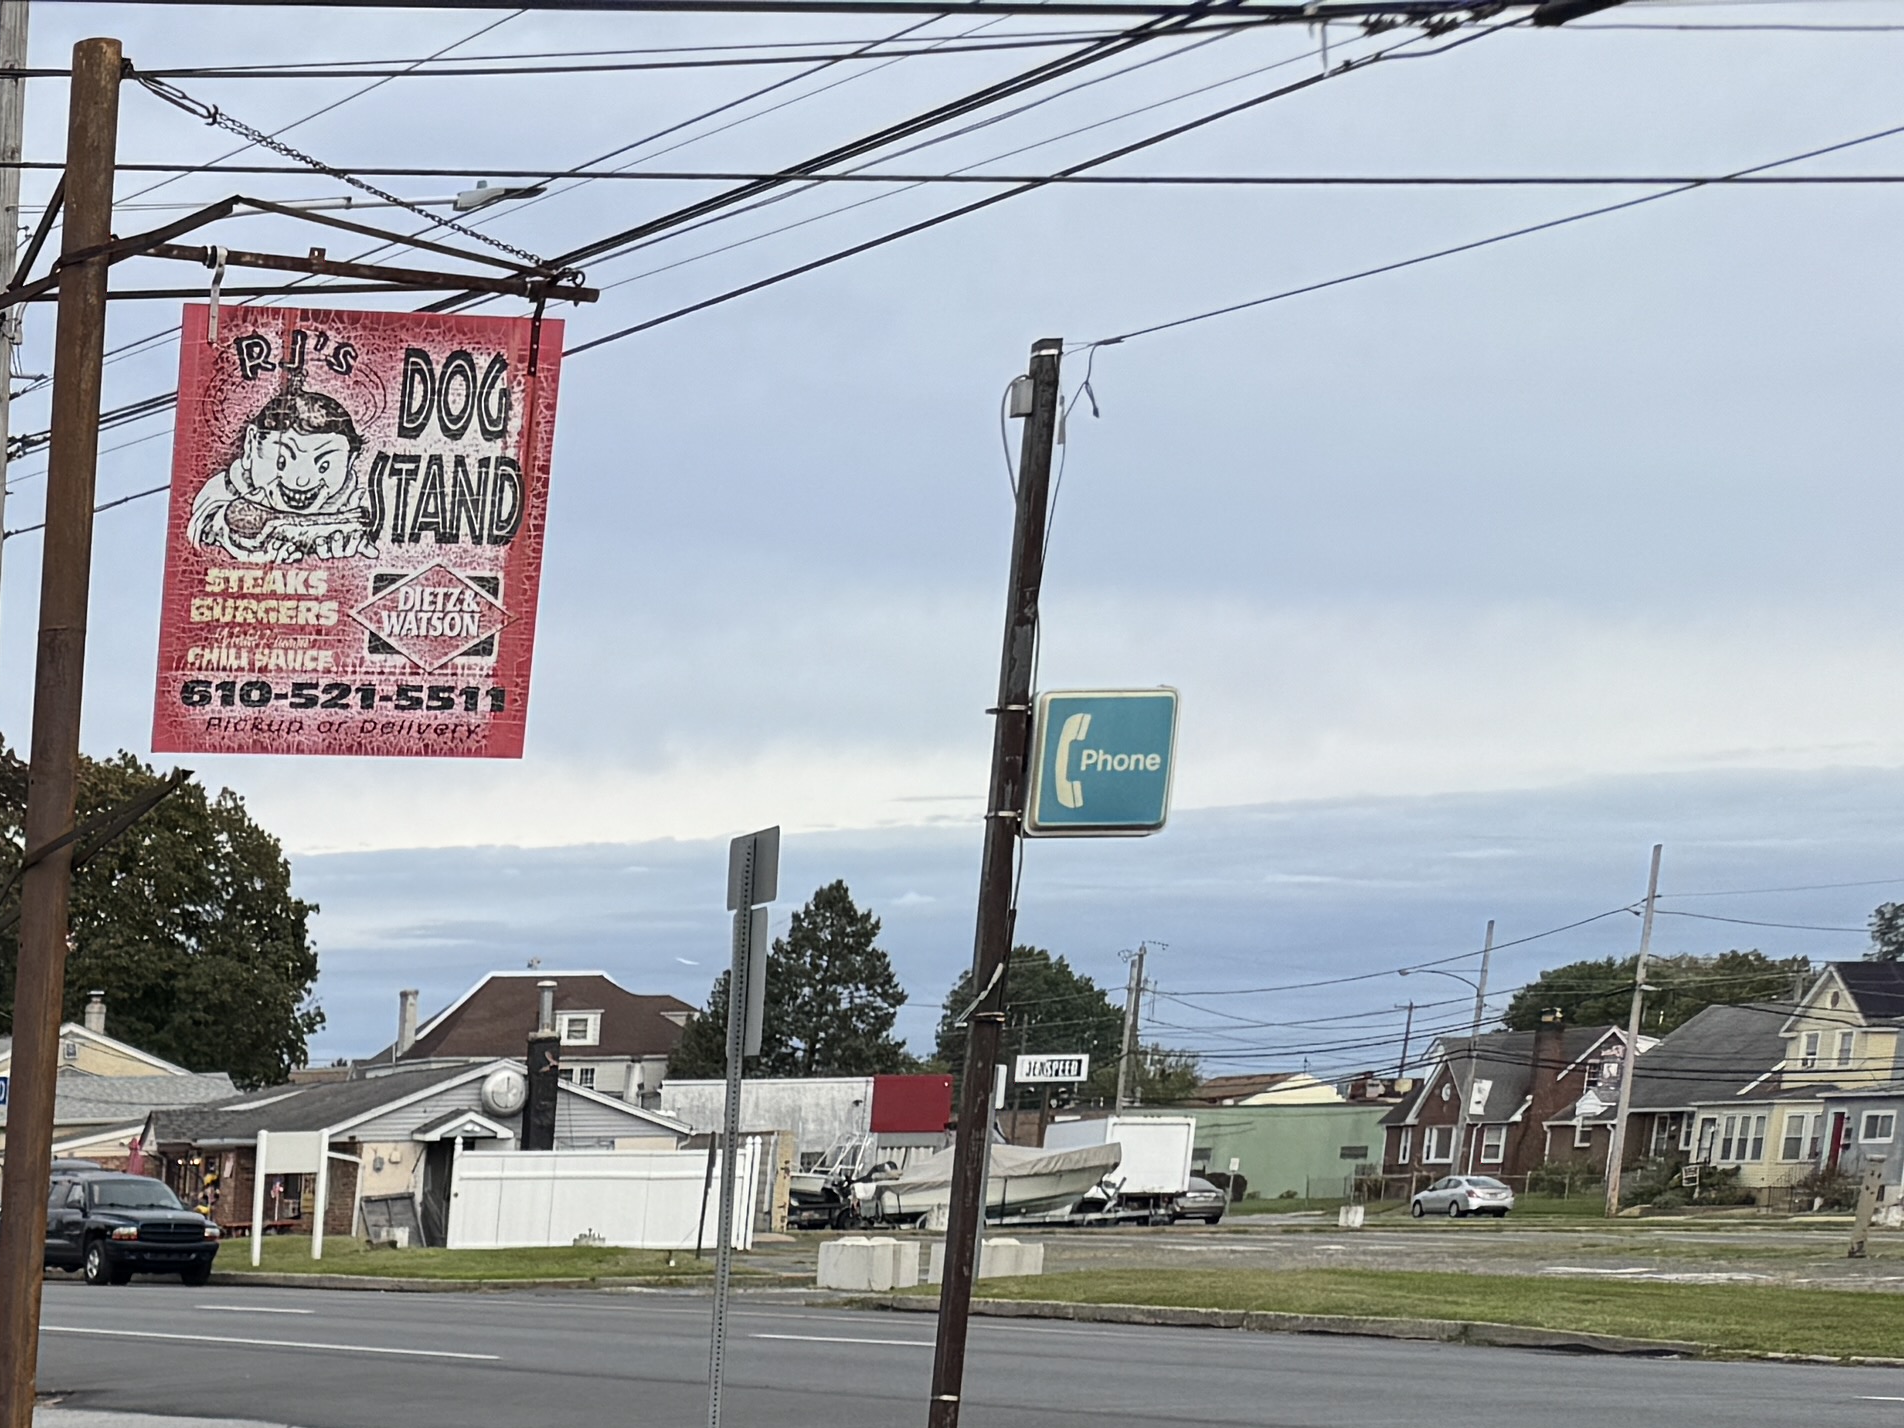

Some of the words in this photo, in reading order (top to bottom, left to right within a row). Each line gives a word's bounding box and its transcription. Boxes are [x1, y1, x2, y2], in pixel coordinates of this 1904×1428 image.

[398, 347, 512, 441] DOG
[366, 451, 525, 545] STAND
[205, 568, 328, 596] STEAKS
[190, 597, 339, 626] BURGERS
[381, 611, 481, 637] WATSON
[187, 645, 249, 671] CHILI
[255, 648, 337, 672] SAUCE
[180, 679, 506, 712] 610-521-5511
[317, 720, 348, 734] or
[360, 720, 481, 739] Delivery
[1080, 749, 1161, 771] Phone
